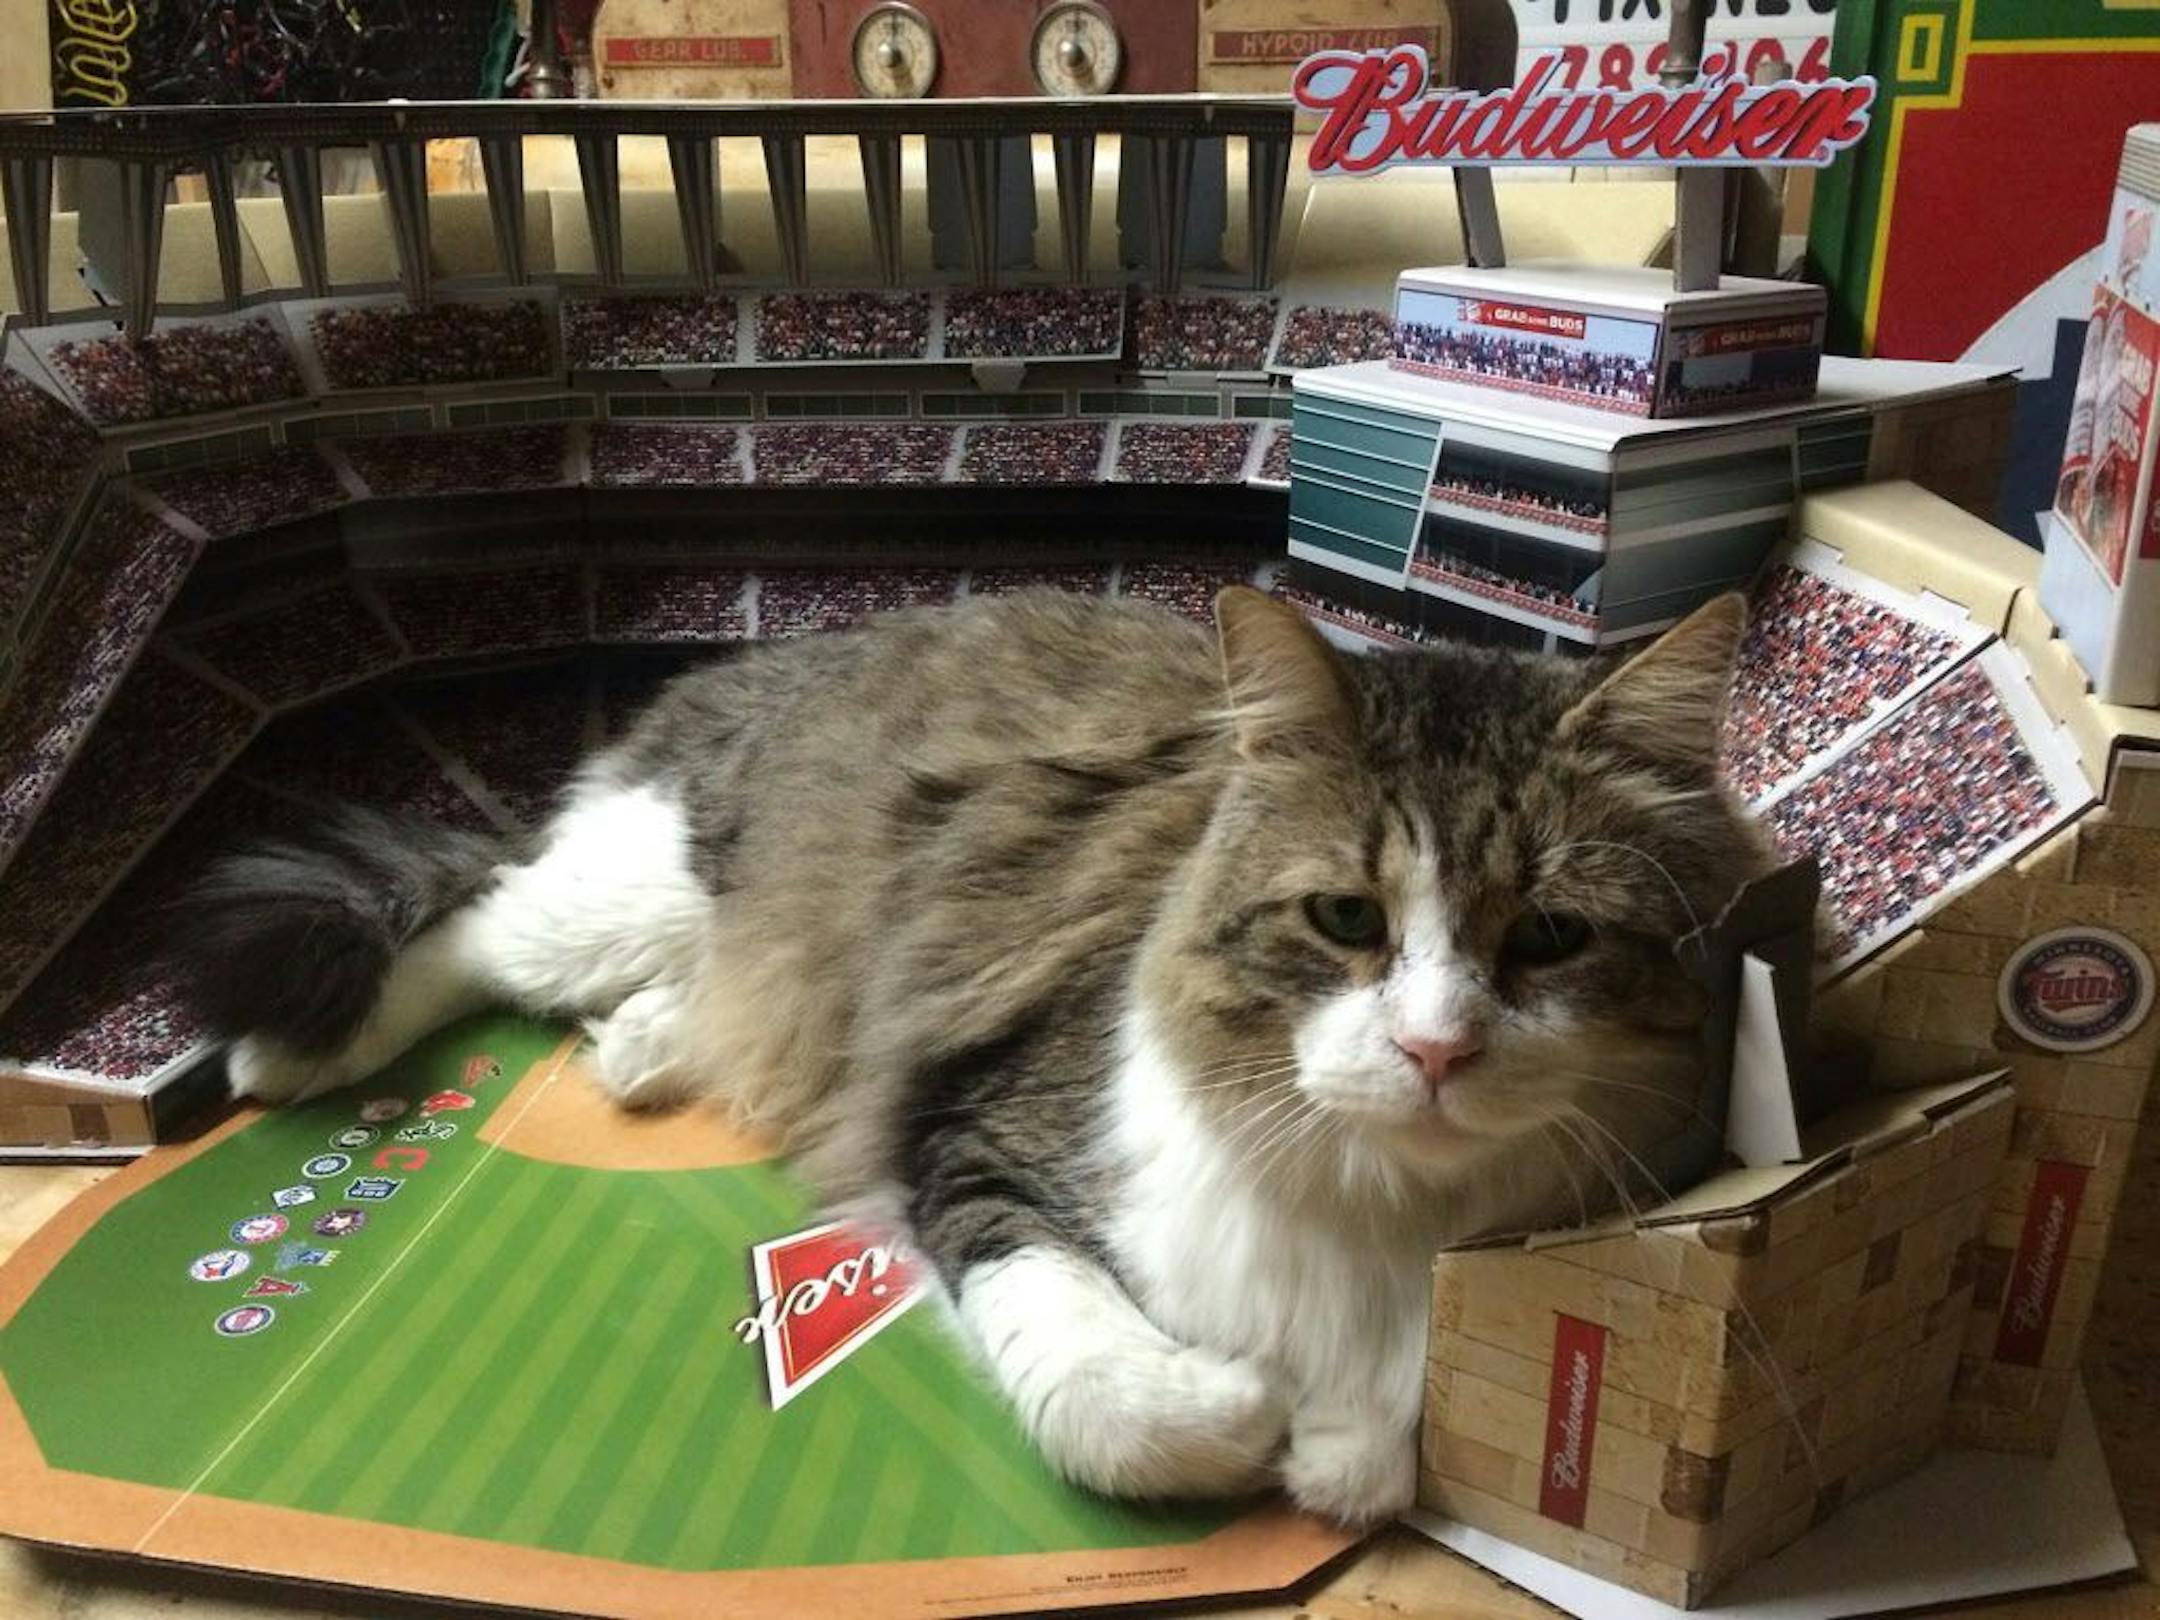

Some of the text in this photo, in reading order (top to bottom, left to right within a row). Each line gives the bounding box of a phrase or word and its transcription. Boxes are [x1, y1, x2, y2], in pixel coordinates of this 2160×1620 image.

[632, 40, 693, 61] GEAR
[1242, 32, 1334, 56] HYPOID
[1293, 50, 1870, 169] Budweiser
[1494, 308, 1528, 323] GRAB
[1549, 315, 1584, 330] BUDS
[2027, 969, 2129, 1013] Twins
[735, 1236, 912, 1344] iser
[2010, 1194, 2066, 1334] Budweiser
[1552, 1350, 1589, 1489] Budweiser
